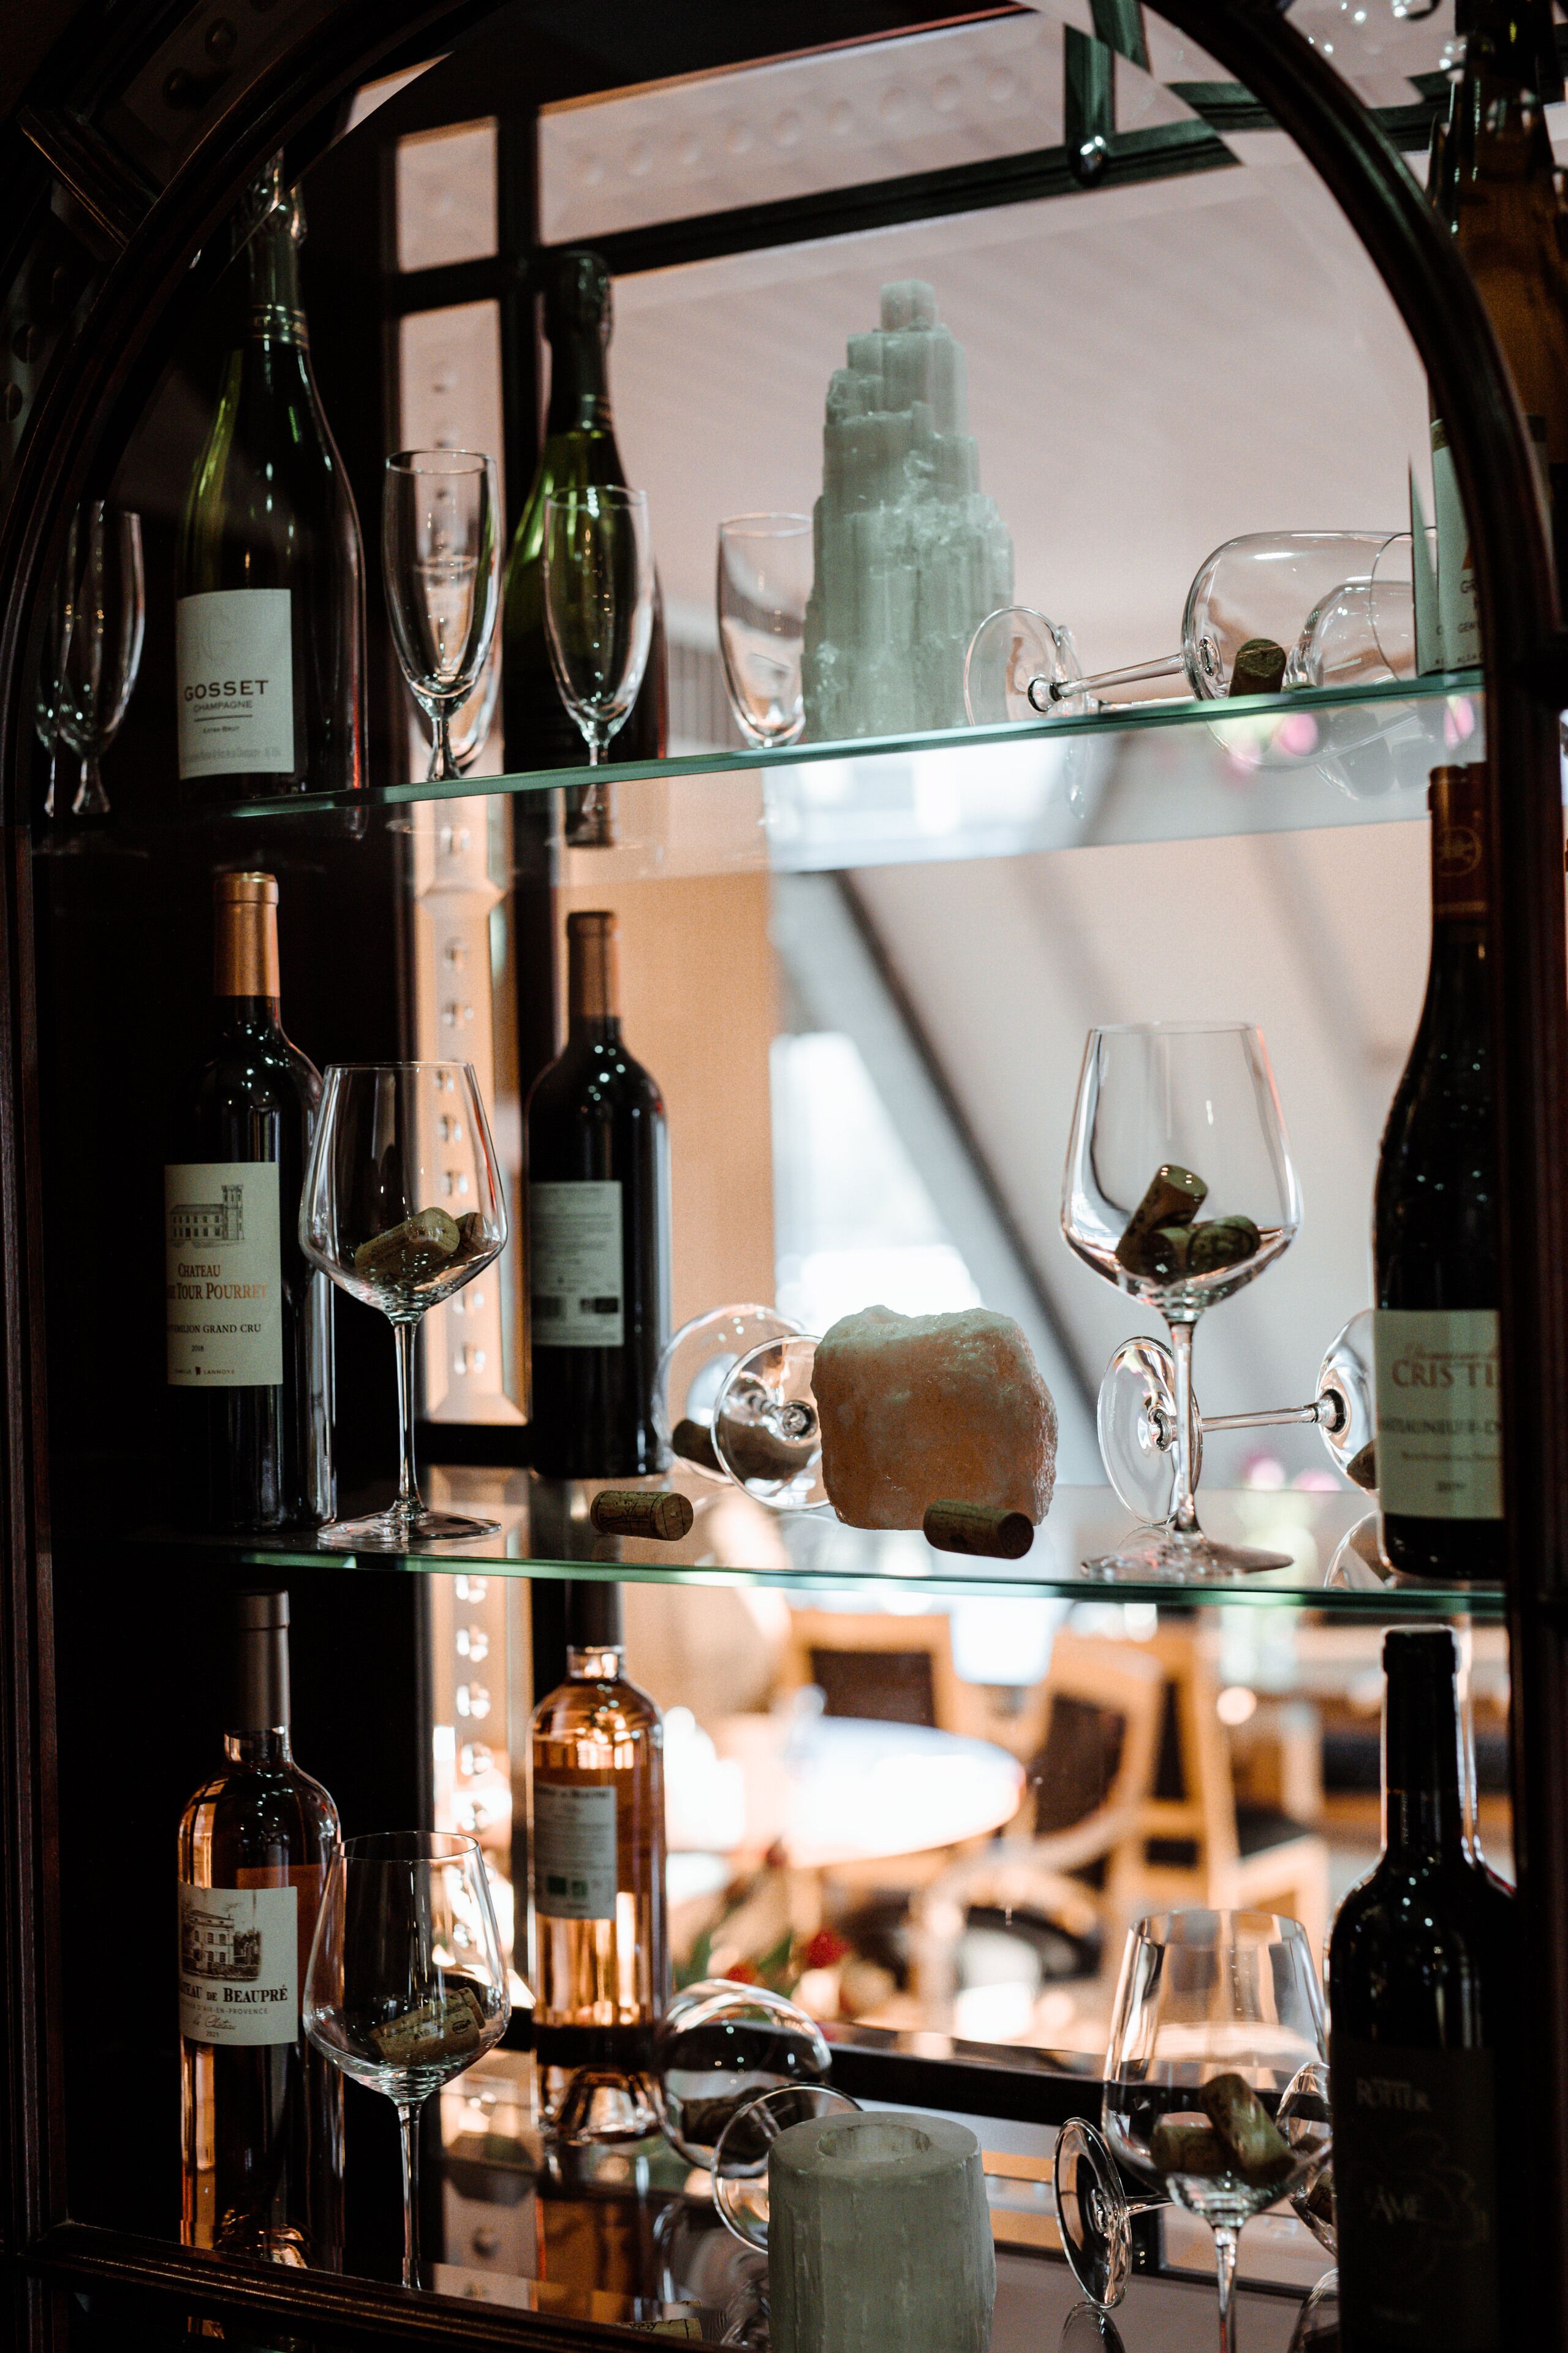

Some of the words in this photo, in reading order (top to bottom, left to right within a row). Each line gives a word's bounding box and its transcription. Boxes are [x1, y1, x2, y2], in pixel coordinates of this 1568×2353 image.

[184, 680, 268, 702] GOSSET
[193, 700, 253, 713] CHAMPAGNE
[177, 1283, 202, 1299] TOUR
[206, 1283, 268, 1299] POURRET
[203, 1324, 237, 1333] GRAND
[240, 1324, 261, 1332] CRU
[1392, 1358, 1498, 1389] CRISTI
[223, 1984, 288, 2003] BEAUPRÉ
